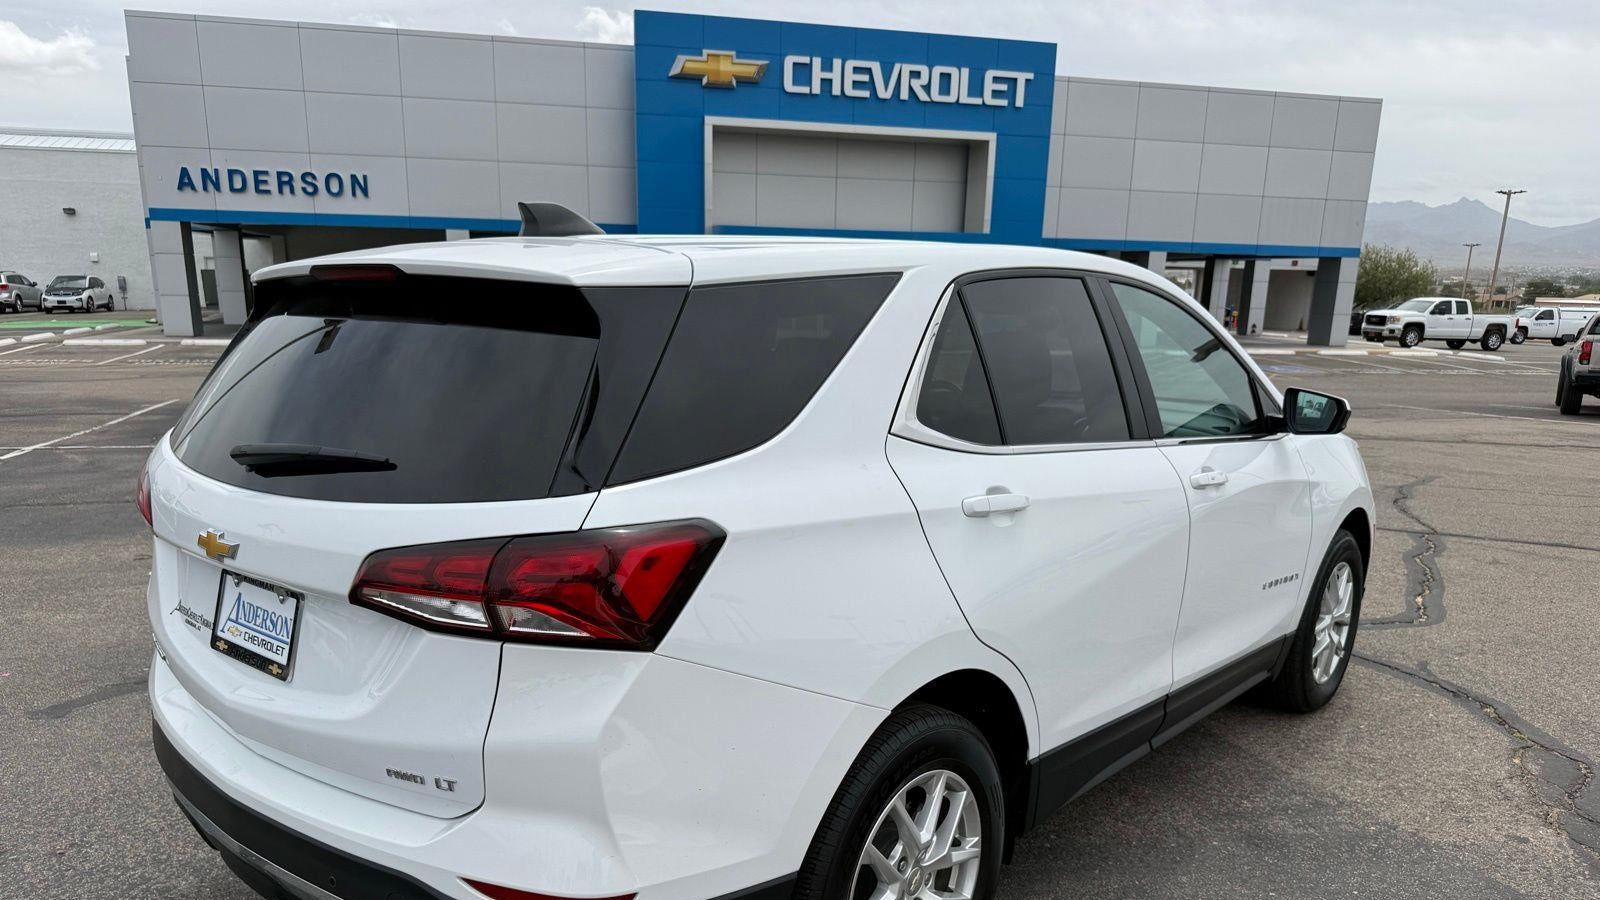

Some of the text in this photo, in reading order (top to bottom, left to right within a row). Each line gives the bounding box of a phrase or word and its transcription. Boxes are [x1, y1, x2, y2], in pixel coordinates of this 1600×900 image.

[783, 54, 1035, 108] CHEVROLET
[177, 166, 370, 198] ANDERSON
[220, 592, 292, 639] ANDERSON
[243, 631, 286, 656] CHEVROLET
[434, 777, 457, 792] LT
